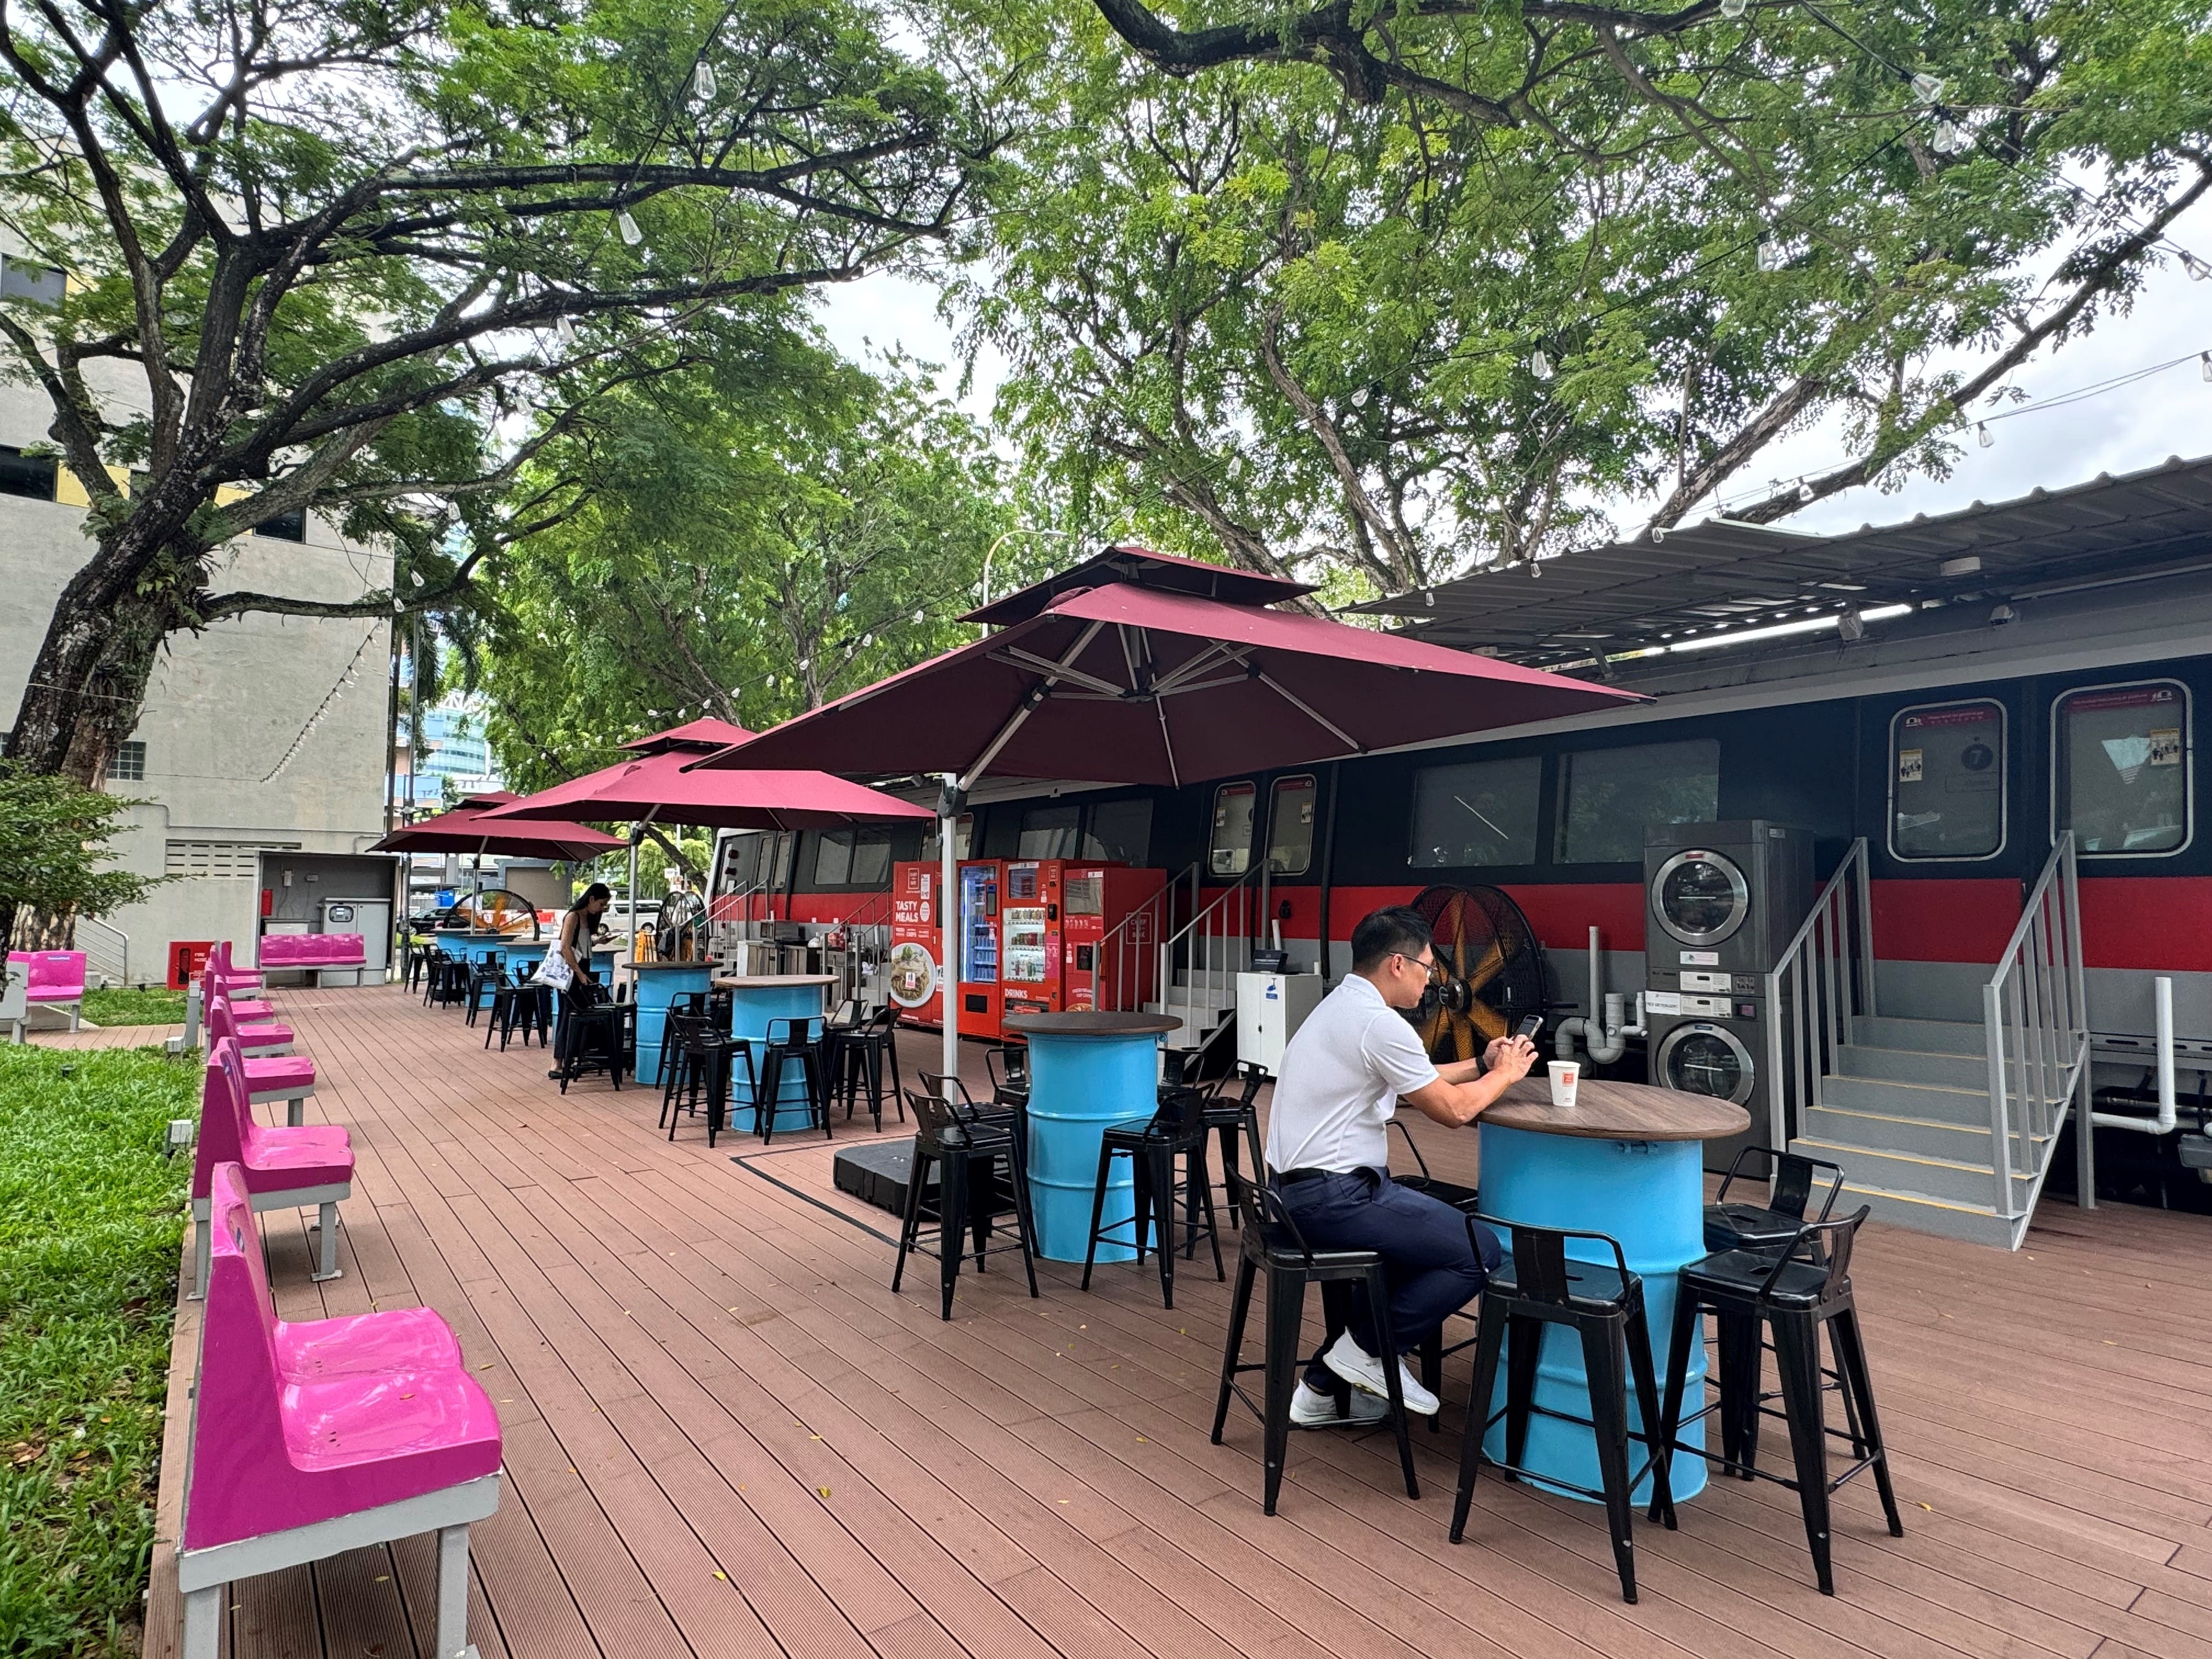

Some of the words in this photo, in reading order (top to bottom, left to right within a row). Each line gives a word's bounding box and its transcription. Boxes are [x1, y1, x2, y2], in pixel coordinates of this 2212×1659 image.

[895, 900, 917, 911] TASTY
[895, 912, 918, 923] MEALS
[1005, 988, 1028, 998] DRINKS
